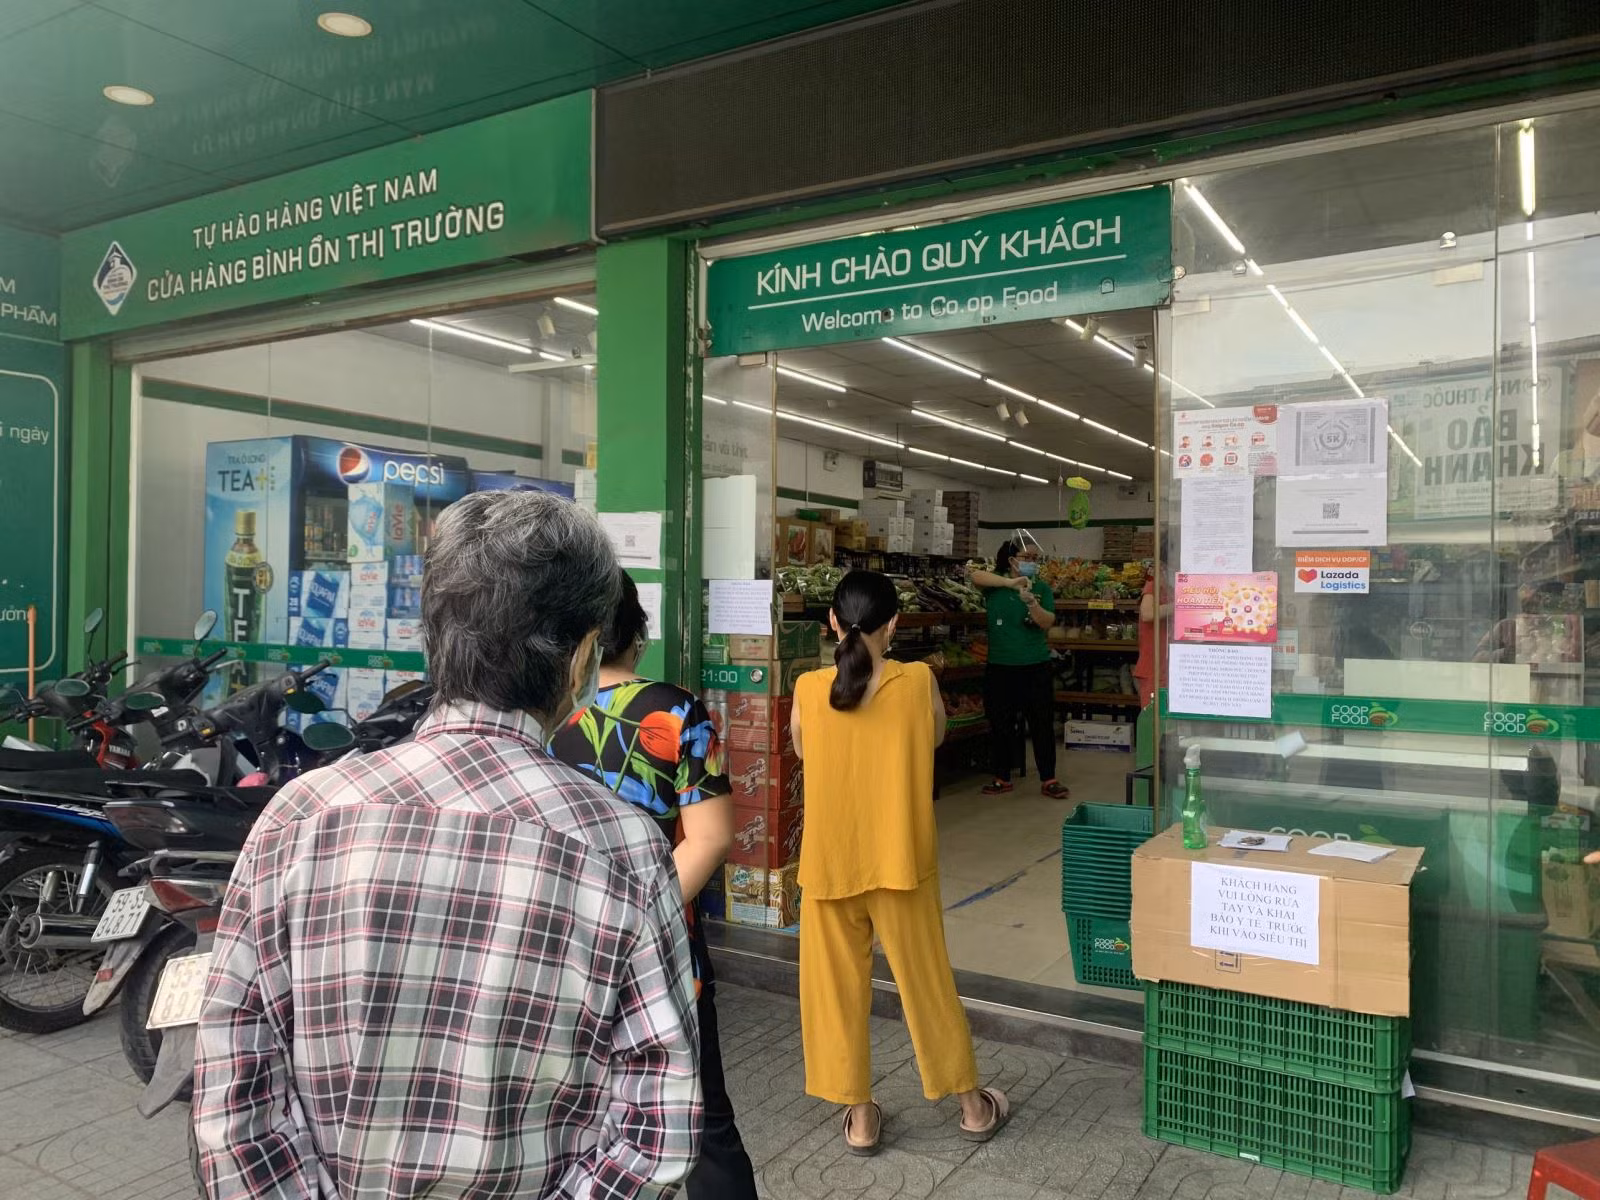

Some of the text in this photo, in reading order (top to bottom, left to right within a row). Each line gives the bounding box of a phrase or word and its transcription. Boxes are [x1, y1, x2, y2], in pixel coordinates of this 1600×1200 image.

[193, 168, 437, 249] TỰ HÀO HÀNG VIỆT NAM
[147, 269, 184, 301] CỬA
[190, 259, 247, 293] HÀNG
[252, 246, 302, 281] BÌNH
[308, 235, 340, 268] ỔN
[346, 228, 384, 260] THỊ
[391, 201, 505, 251] TRƯỜNG
[756, 215, 1121, 296] KÍNH CHÀO QUÝ KHÁCH
[801, 280, 1058, 333] Welcome to Co.op Food
[10, 425, 49, 445] ngày
[383, 460, 444, 487] pepsi
[1321, 571, 1359, 579] Lazada
[1321, 581, 1366, 591] Logistics
[1331, 714, 1369, 725] FOOD
[1483, 722, 1526, 733] FOOD
[1221, 876, 1260, 890] KHÁCH
[1218, 889, 1237, 900] VUI
[1222, 902, 1244, 913] TAY
[1267, 907, 1295, 920] KHAI
[1236, 916, 1244, 926] Y
[1210, 925, 1229, 936] KHI
[1259, 932, 1285, 944] SIÊU
